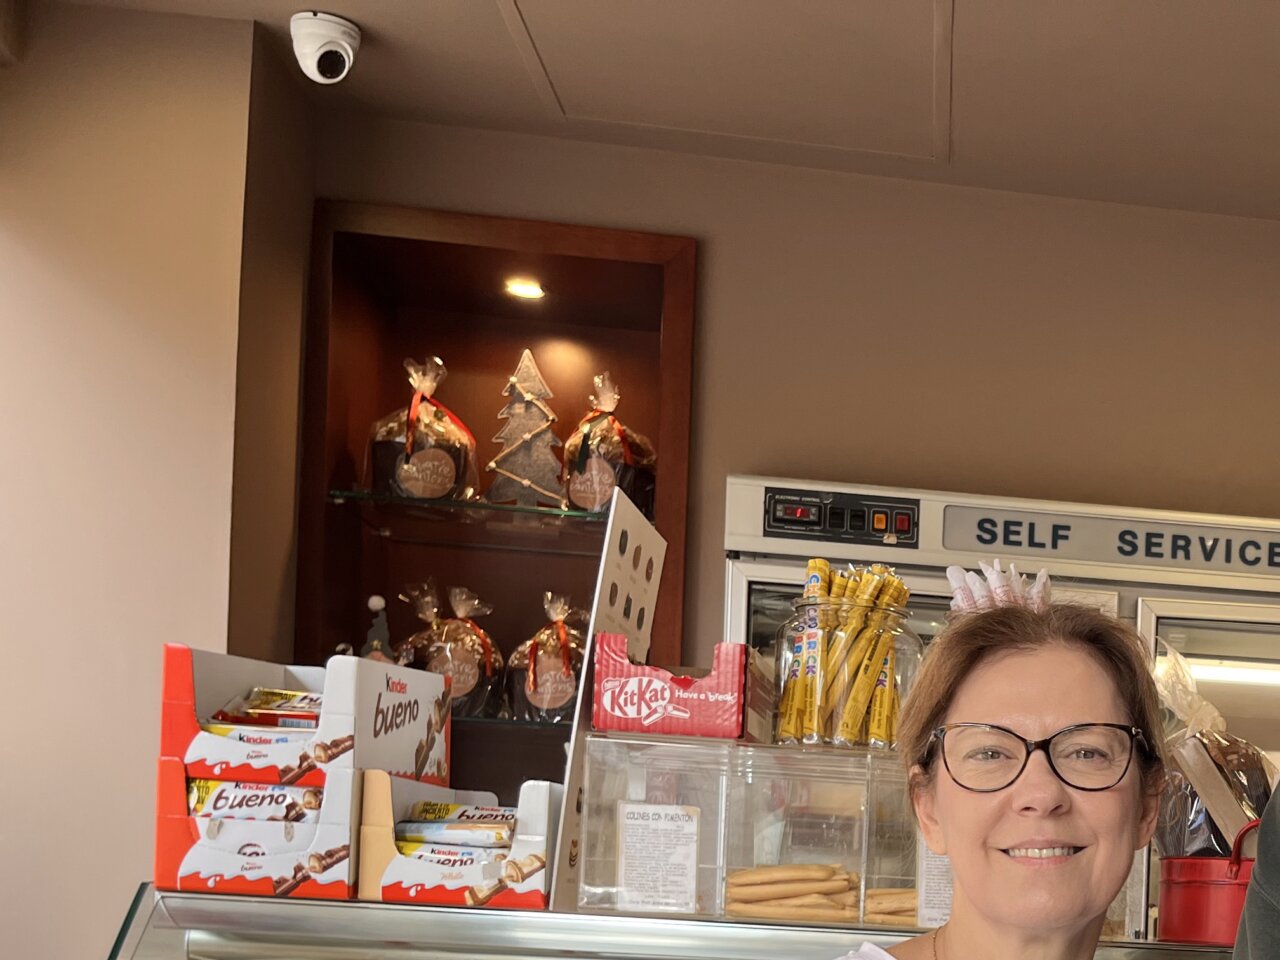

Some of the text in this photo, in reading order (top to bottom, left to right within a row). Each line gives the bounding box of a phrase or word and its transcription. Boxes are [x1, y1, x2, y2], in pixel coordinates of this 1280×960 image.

[976, 518, 1071, 550] SELF
[610, 678, 668, 716] KitKat
[675, 689, 698, 699] Have
[373, 692, 419, 738] bueno
[239, 733, 272, 745] kinder
[213, 789, 287, 811] bueno
[458, 809, 515, 820] bueno
